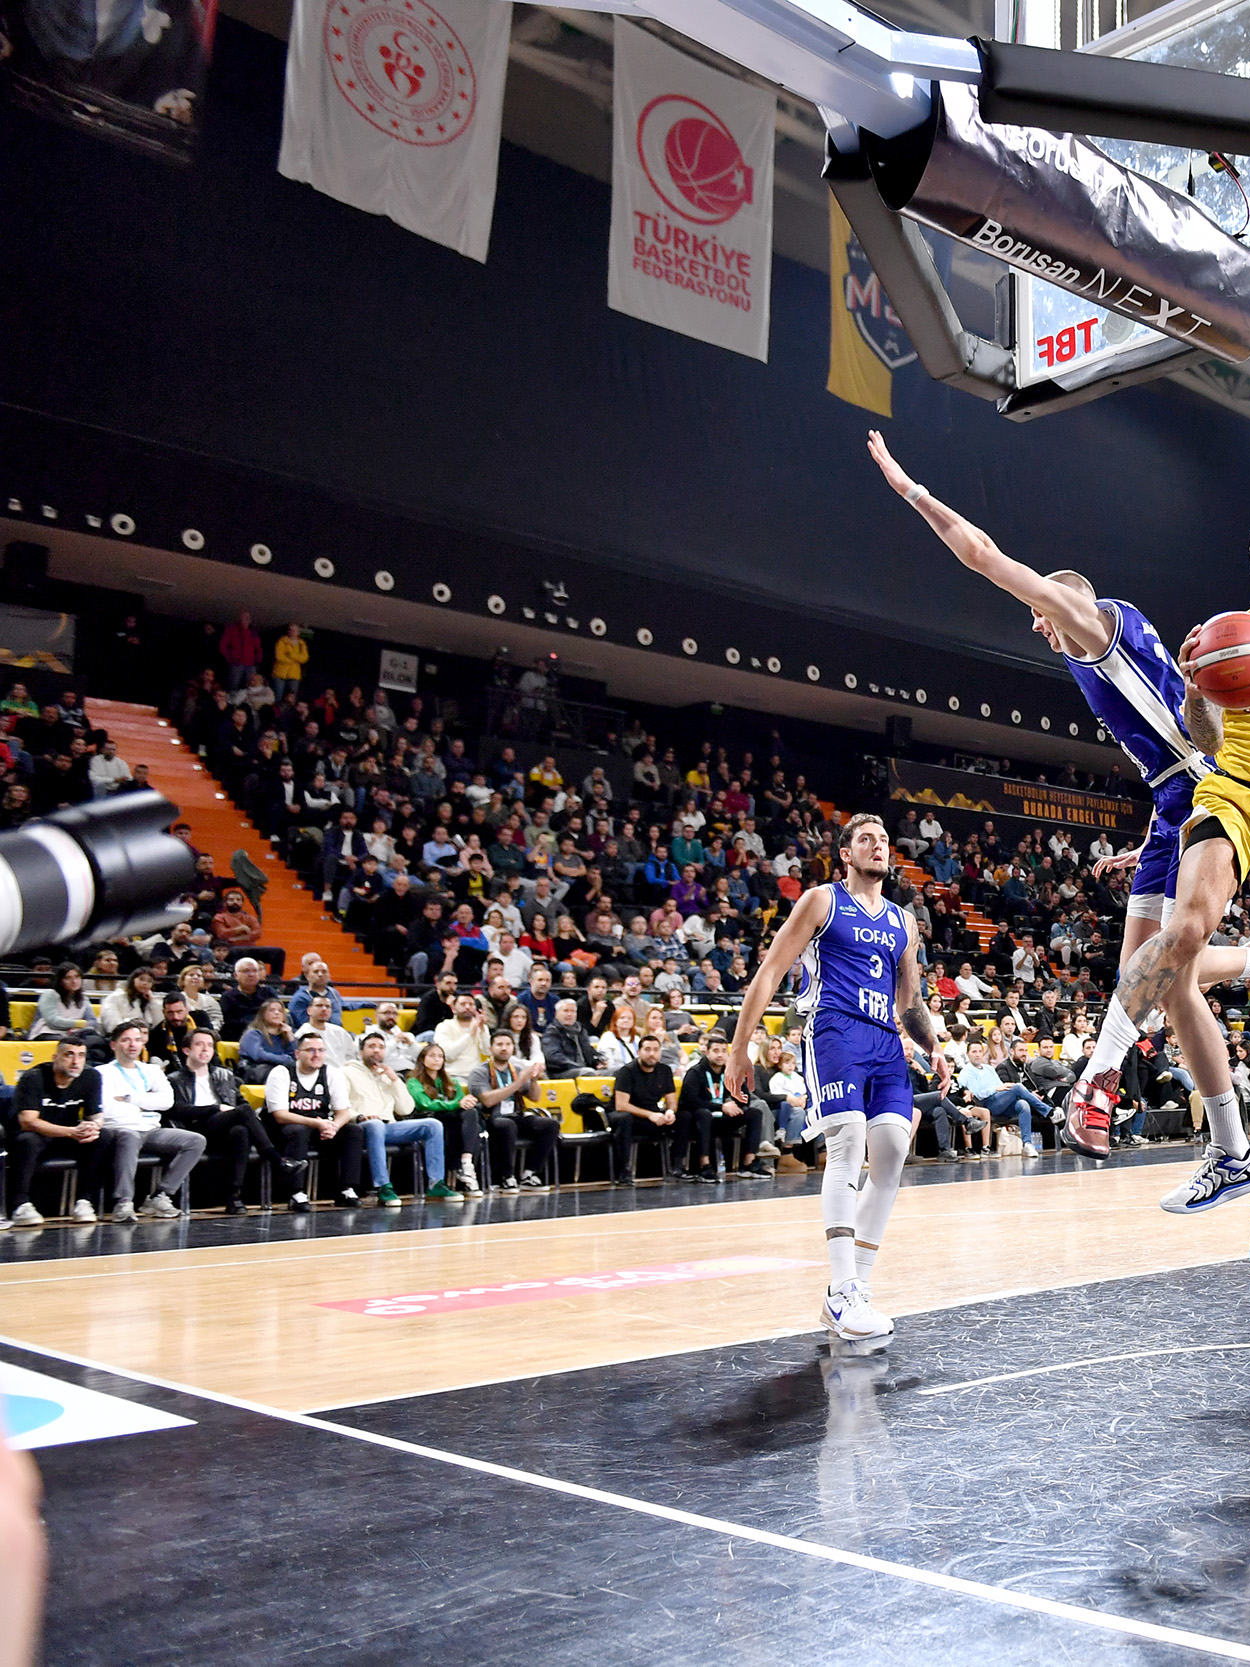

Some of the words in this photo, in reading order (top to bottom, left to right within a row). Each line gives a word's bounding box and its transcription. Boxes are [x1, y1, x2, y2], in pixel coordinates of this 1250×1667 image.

[633, 210, 751, 278] TÜRKİYE
[633, 236, 751, 297] BASKETBOL
[972, 218, 1081, 284] Borusan
[1079, 268, 1212, 338] NEXT
[632, 256, 751, 312] FEDERASYONU
[1023, 800, 1063, 820] BURADA
[1067, 806, 1095, 825] ENGEL
[1099, 812, 1116, 828] YOK
[852, 926, 897, 952] TOFAŞ
[869, 954, 883, 979] 3
[859, 986, 890, 1024] FIAT
[290, 1097, 322, 1111] MSK
[821, 1080, 844, 1102] FIAT
